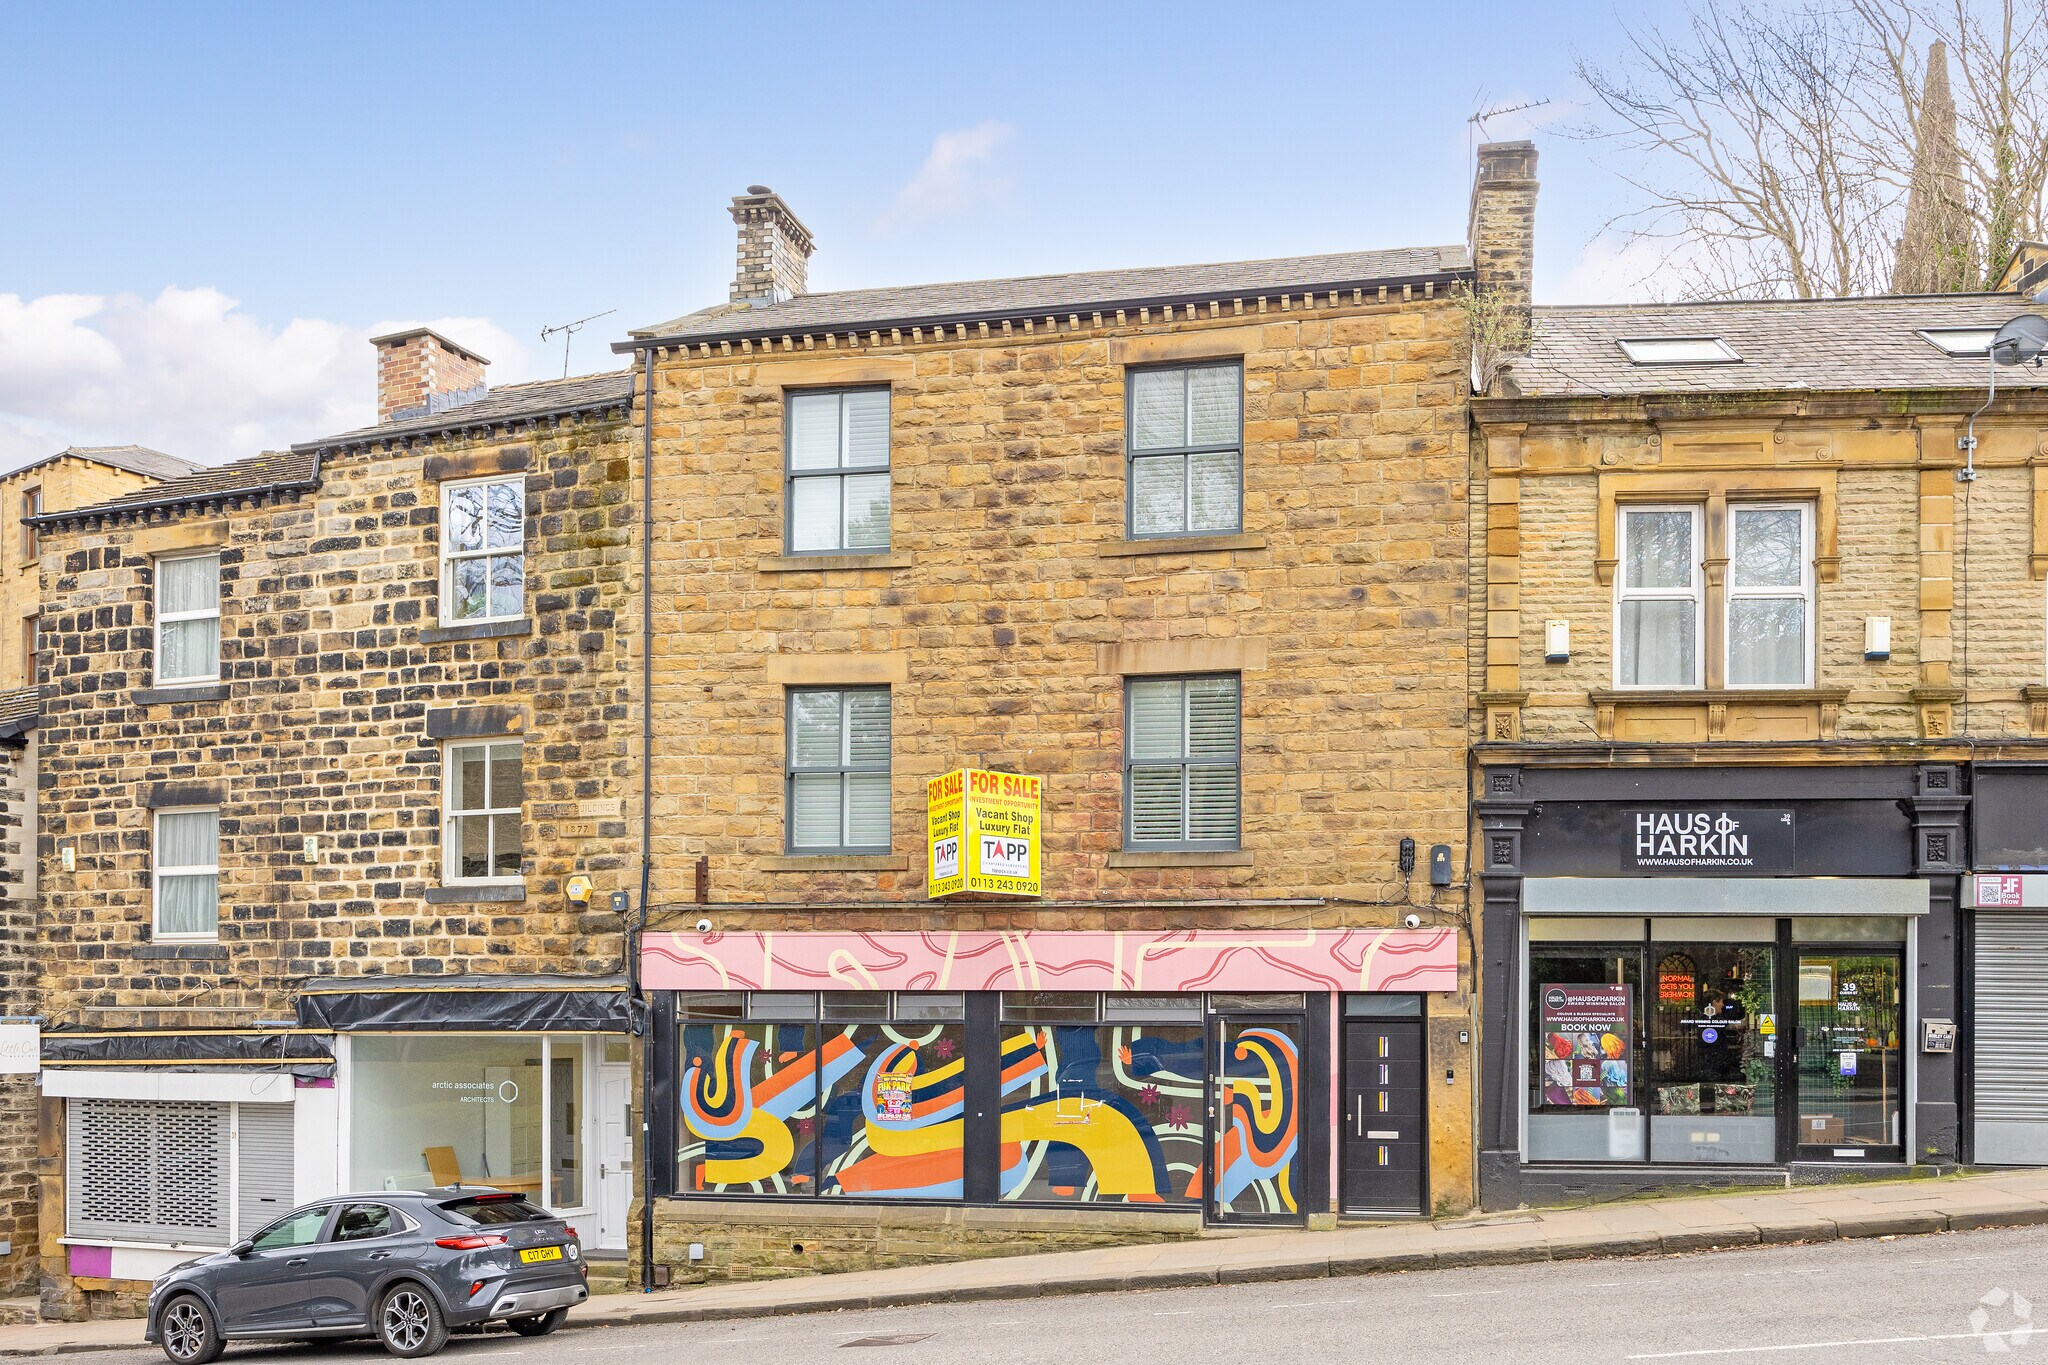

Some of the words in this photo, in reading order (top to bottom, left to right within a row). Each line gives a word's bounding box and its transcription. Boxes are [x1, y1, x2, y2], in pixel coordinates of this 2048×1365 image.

[929, 780, 942, 802] FOR
[945, 772, 962, 797] SALE
[970, 772, 998, 794] FOR
[1004, 776, 1038, 799] SALE
[970, 797, 1002, 805] INVESTMENT
[1004, 800, 1038, 809] OPPORTUNITY
[932, 814, 947, 825] Vacant
[948, 810, 960, 822] Shop
[976, 808, 1008, 820] Vacant
[1012, 812, 1033, 825] Shop
[1636, 813, 1710, 834] HAUS
[1715, 813, 1739, 834] OF
[933, 826, 948, 837] Luxury
[950, 822, 958, 833] Flat
[980, 821, 1010, 835] Luxury
[1014, 824, 1030, 835] Flat
[983, 840, 1027, 861] TAPP
[1636, 835, 1747, 855] HARKIN
[935, 842, 957, 864] TAPP
[930, 883, 941, 895] 0113
[942, 881, 950, 892] 243
[952, 878, 963, 890] 0920
[971, 878, 993, 888] 0113
[997, 880, 1013, 890] 243
[1017, 881, 1038, 892] 0920
[1843, 983, 1856, 991] 39
[878, 1082, 890, 1091] FUN
[893, 1081, 910, 1092] PARK
[541, 1249, 553, 1258] GHY
[570, 1248, 576, 1256] UK
